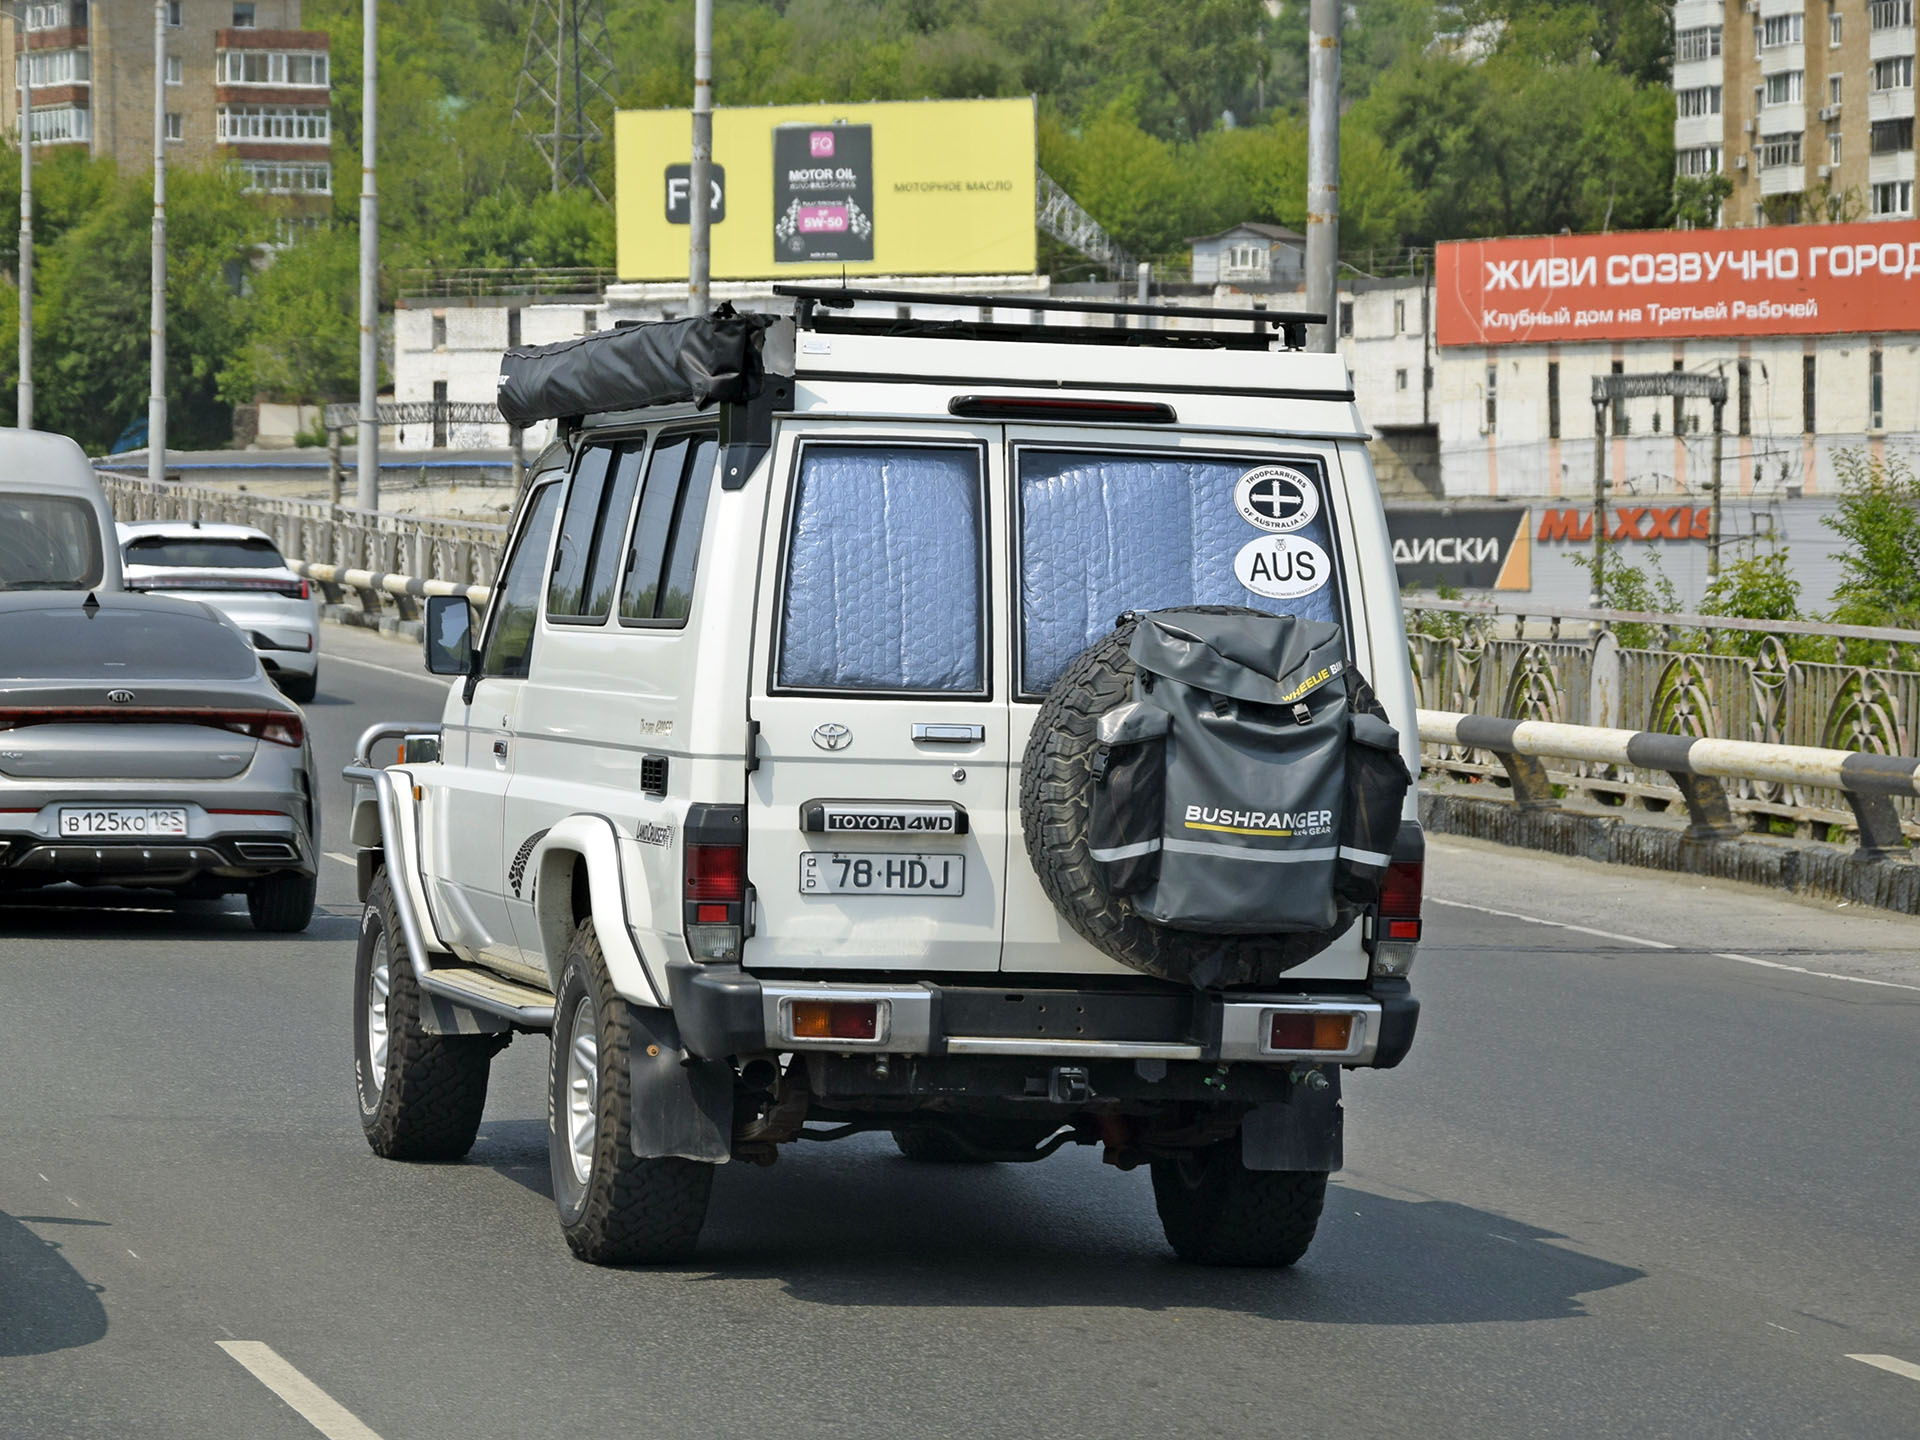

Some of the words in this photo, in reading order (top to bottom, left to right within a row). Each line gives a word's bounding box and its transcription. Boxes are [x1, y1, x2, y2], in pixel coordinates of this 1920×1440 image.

[788, 168, 833, 182] MOTOR
[835, 167, 857, 181] OIL
[893, 181, 962, 193] МОТОРНОЕ
[965, 180, 1013, 191] МАСЛО
[804, 216, 843, 228] 5W-50
[1484, 256, 1598, 291] ЖИВИ
[1606, 247, 1799, 286] СОЗВУЧНО
[1483, 306, 1571, 330] Клубный
[1575, 308, 1614, 326] дом
[1617, 307, 1643, 323] на
[1646, 301, 1728, 325] Третьей
[1732, 298, 1818, 320] Рабочей
[1245, 470, 1308, 489] TROOPCARRIERS
[1243, 506, 1254, 517] OF
[1254, 516, 1300, 528] AUSTRALIA
[1537, 505, 1711, 542] MAXXIS
[1250, 551, 1316, 582] AUS
[1281, 667, 1331, 702] WHEELIE
[111, 693, 131, 702] KIA
[833, 815, 900, 830] TOYOTA
[907, 816, 953, 831] 4WD
[1185, 804, 1333, 829] BUSHRANGER
[1309, 826, 1332, 836] GEAR
[806, 858, 817, 888] QLD
